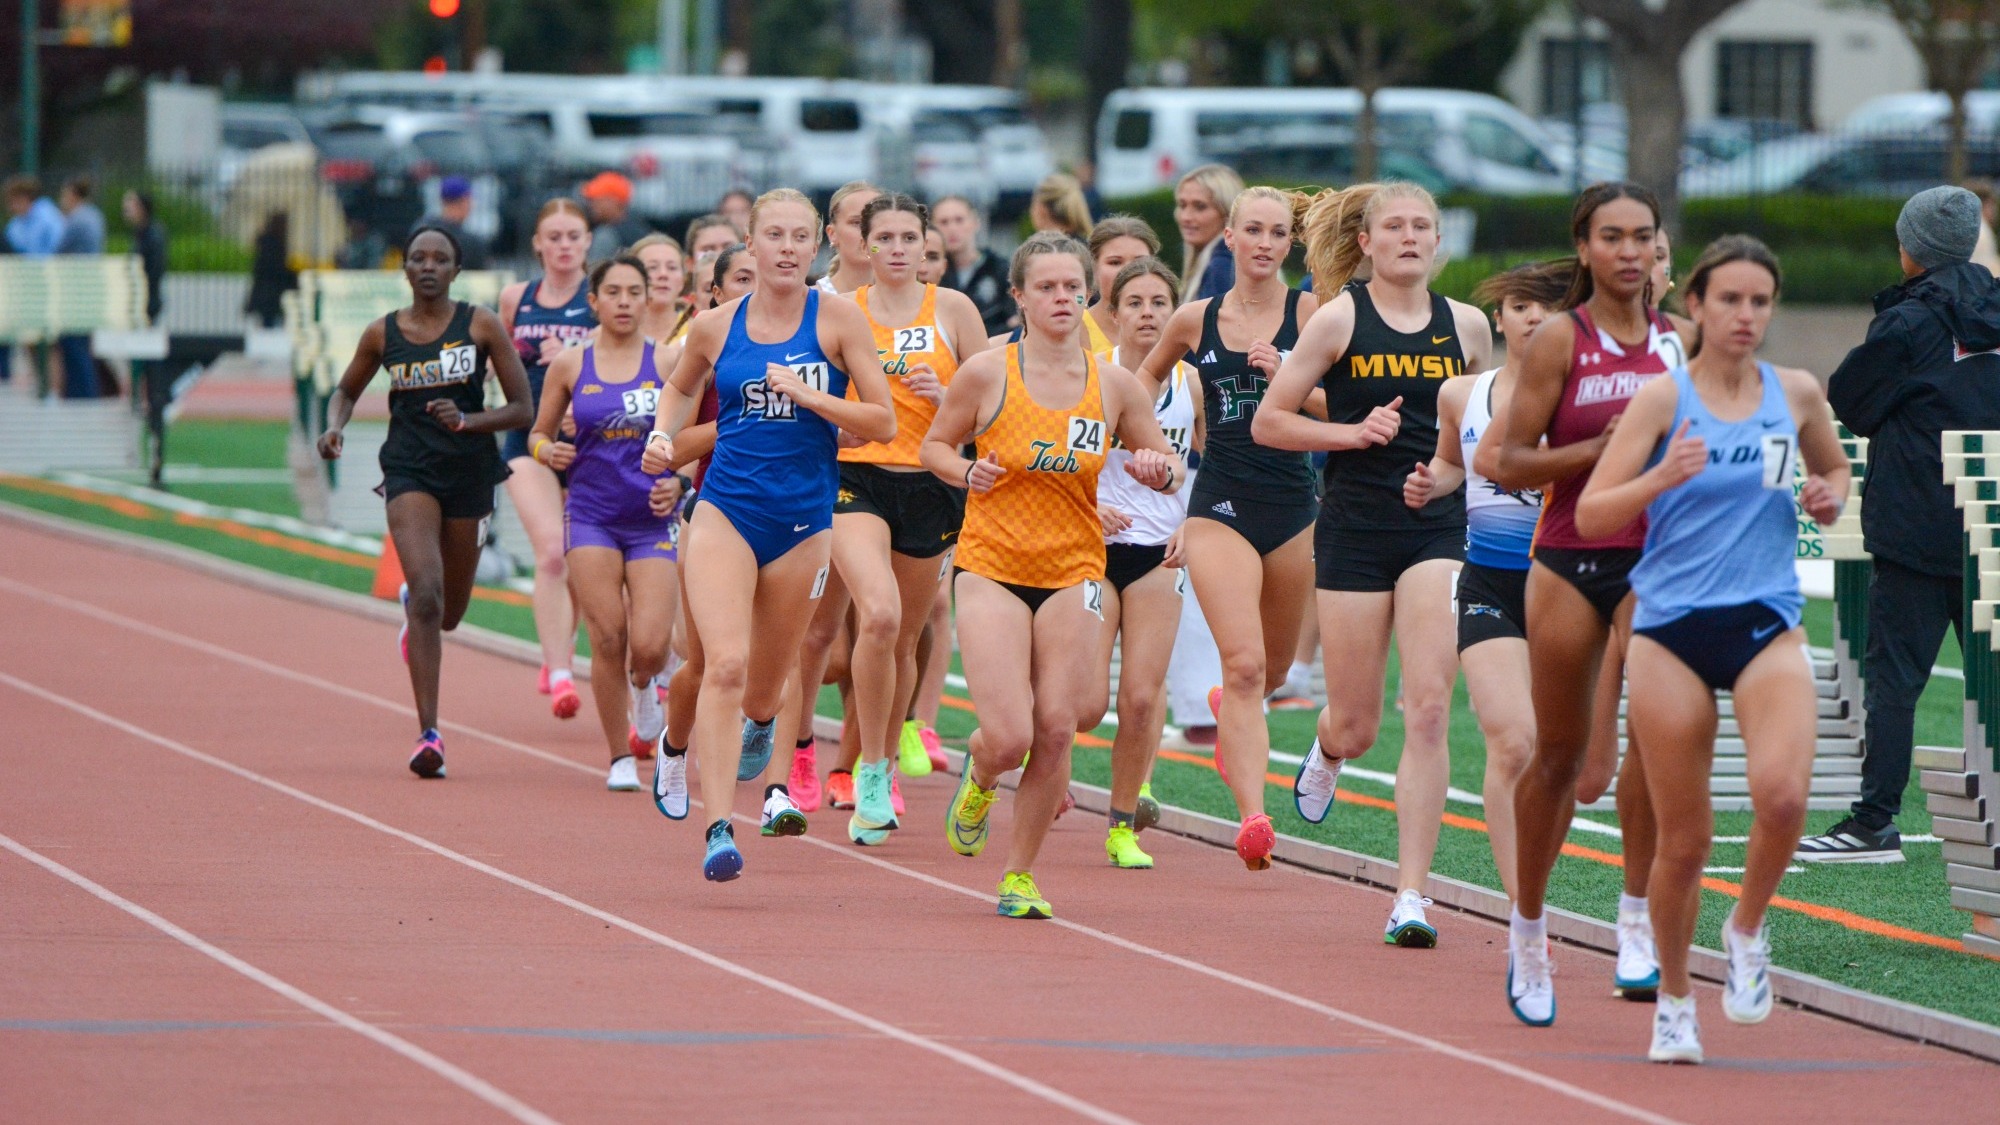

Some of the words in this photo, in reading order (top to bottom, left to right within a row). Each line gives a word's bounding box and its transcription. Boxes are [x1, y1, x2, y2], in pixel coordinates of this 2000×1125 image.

[900, 328, 927, 351] 23
[447, 349, 471, 374] 26
[1350, 354, 1462, 378] MWSU
[797, 364, 821, 393] 11
[625, 390, 656, 415] 33
[740, 380, 797, 423] SM
[1072, 418, 1100, 451] 24
[1026, 440, 1080, 474] Tech
[1771, 438, 1788, 484] 7
[1212, 505, 1237, 517] adidas
